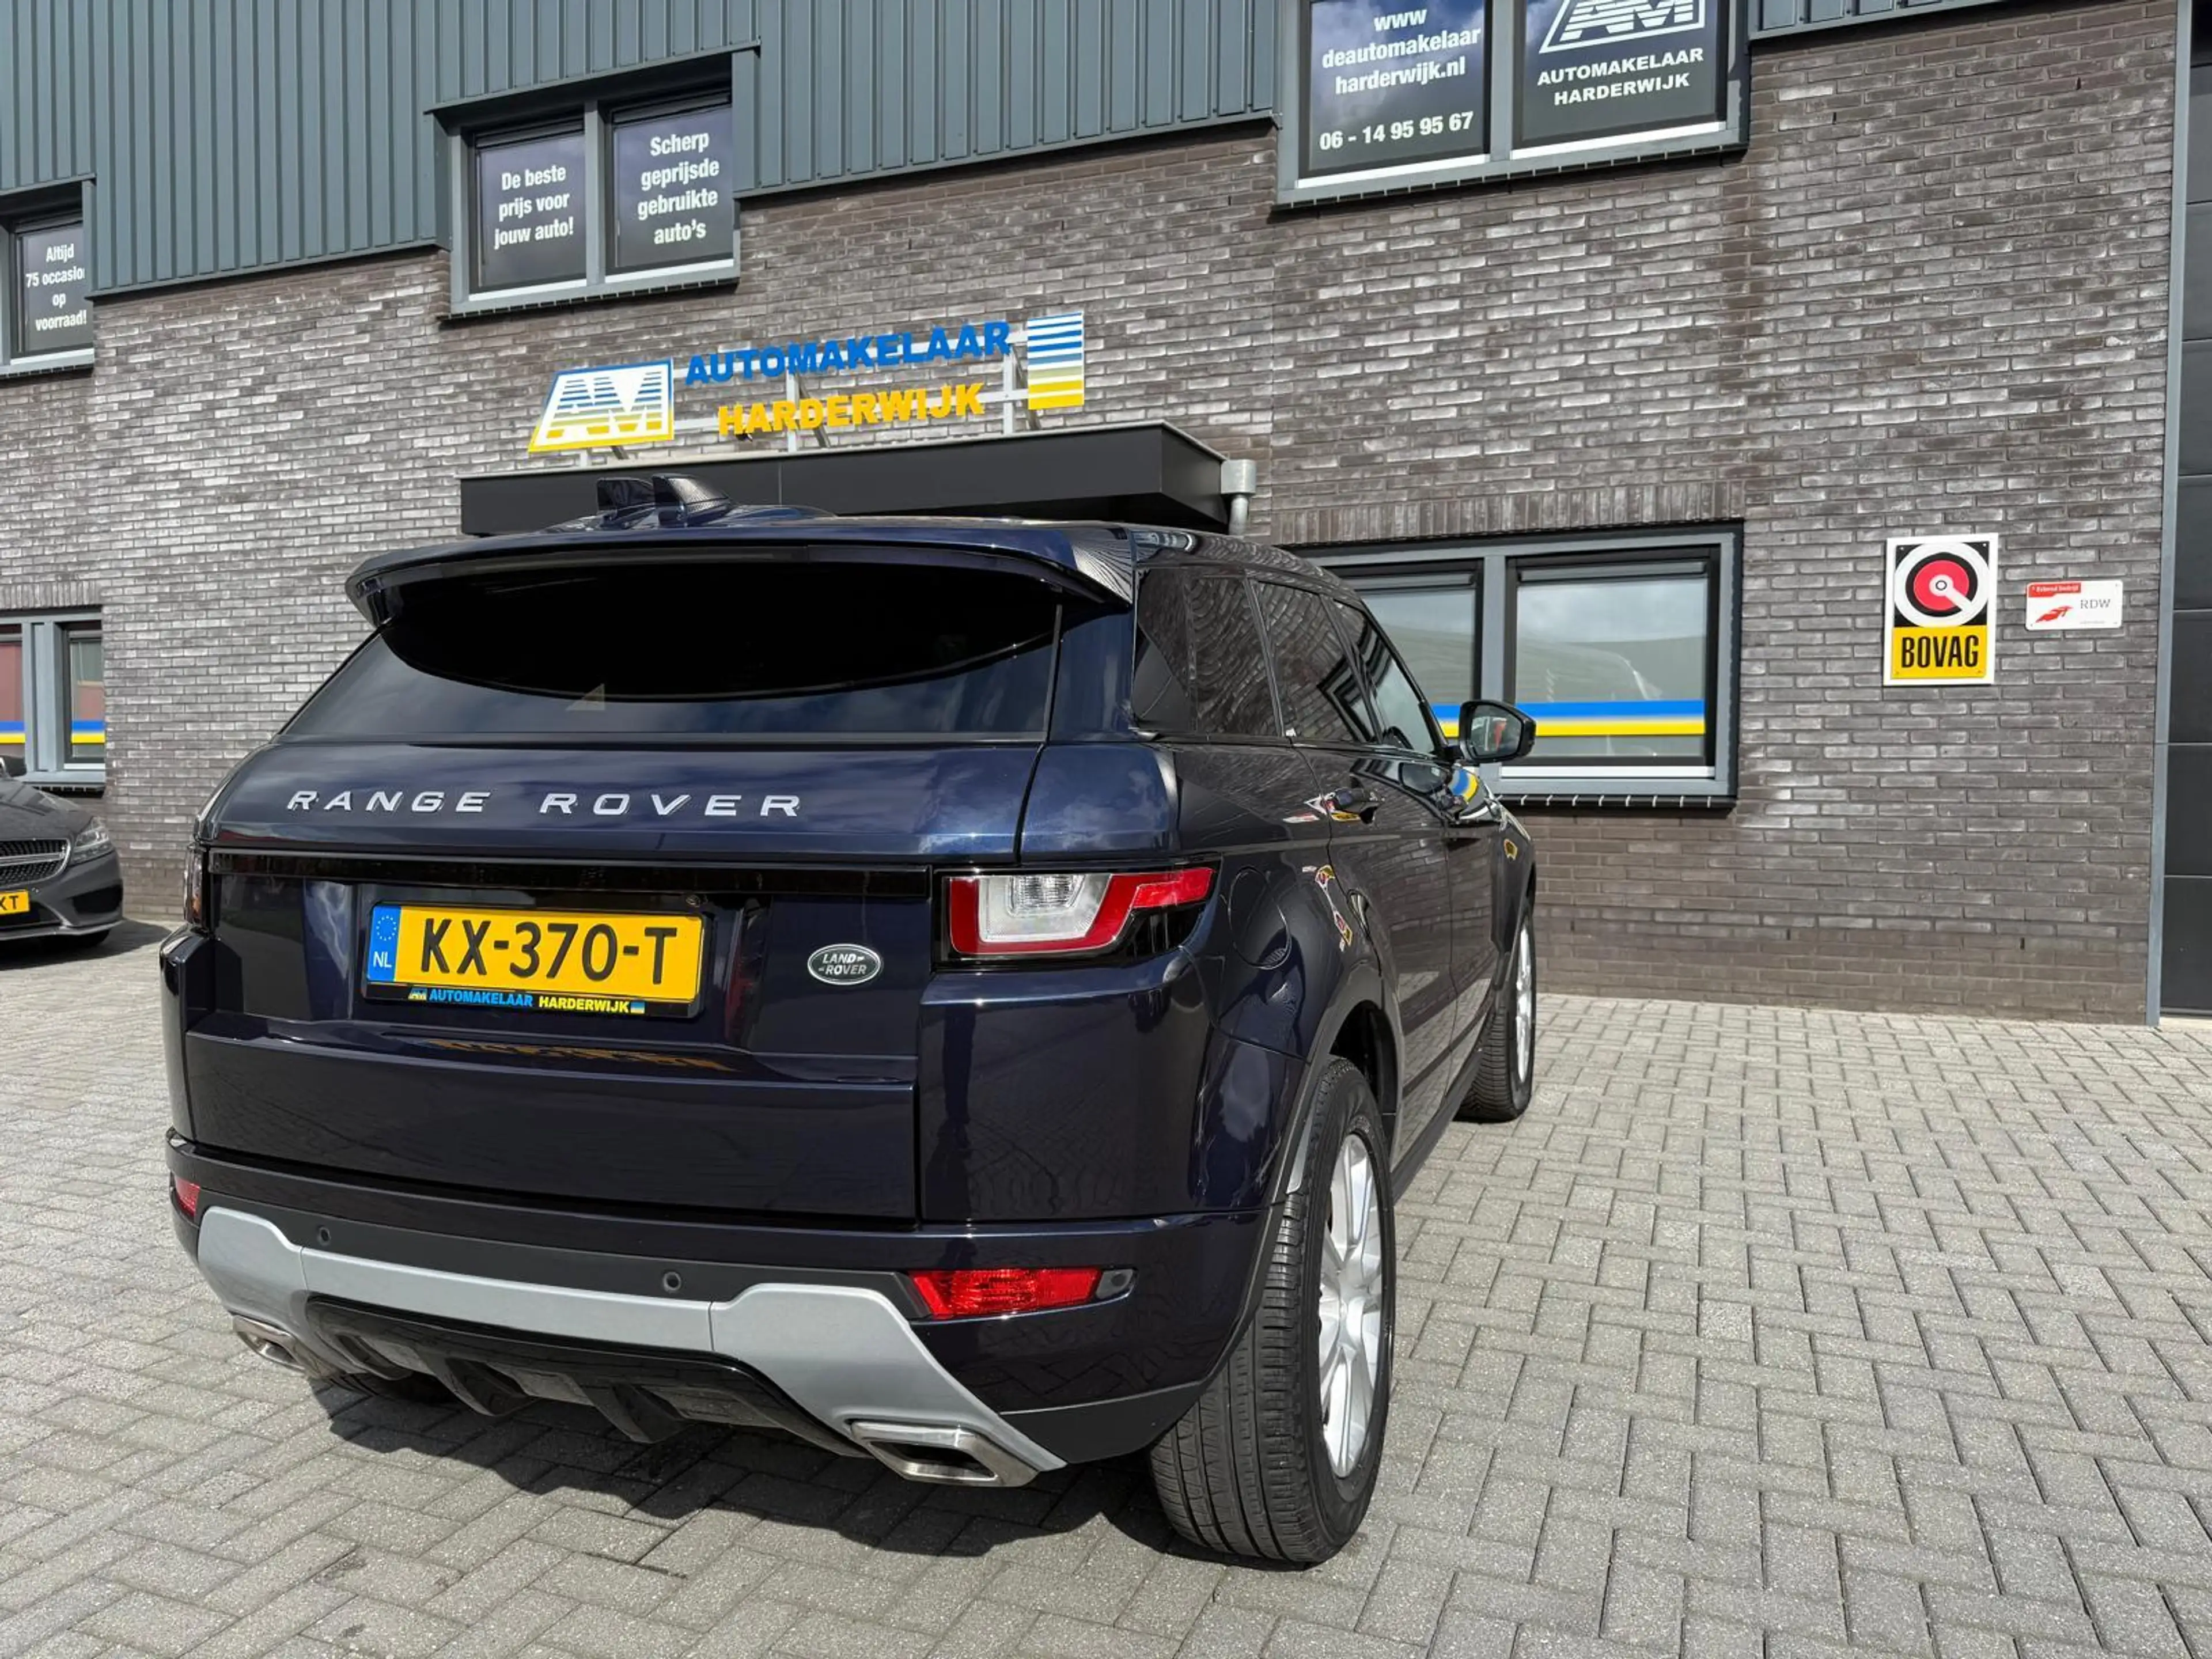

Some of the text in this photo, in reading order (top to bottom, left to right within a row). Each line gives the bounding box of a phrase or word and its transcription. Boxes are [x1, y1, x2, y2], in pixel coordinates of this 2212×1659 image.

[1374, 9, 1427, 31] www
[1322, 28, 1481, 68] deautomakelaar
[1335, 56, 1466, 94] harderwijk.nl
[1537, 47, 1704, 86] AUTOMAKELAAR
[1554, 73, 1690, 106] HARDERWIJK
[1320, 131, 1343, 150] 06
[1362, 124, 1386, 144] 14
[1391, 120, 1414, 140] 95
[1420, 116, 1443, 135] 95
[1449, 111, 1474, 131] 67
[650, 132, 710, 157] Scherp
[502, 164, 566, 191] De beste
[641, 157, 720, 192] geprijsde
[499, 192, 570, 222] prijs voor
[637, 188, 718, 221] gebruikte
[494, 215, 574, 250] jouw auto!
[654, 218, 707, 244] auto's
[46, 243, 74, 263] Altijd
[26, 272, 39, 288] 75
[52, 293, 66, 308] op
[35, 309, 87, 331] voorraad!
[685, 321, 1010, 385] AUTOMAKELAAR
[718, 382, 984, 435] HARDERWIJK
[2080, 599, 2111, 610] RDW
[1901, 635, 1979, 668] BOVAG
[287, 790, 800, 817] RANGE ROVER
[373, 951, 392, 968] NL
[421, 918, 677, 984] KX-370-T
[823, 953, 857, 964] LAND
[825, 964, 868, 975] ROVER
[429, 988, 533, 1007] AUTOMAKELAAR
[539, 995, 630, 1013] HARDERWIJK
